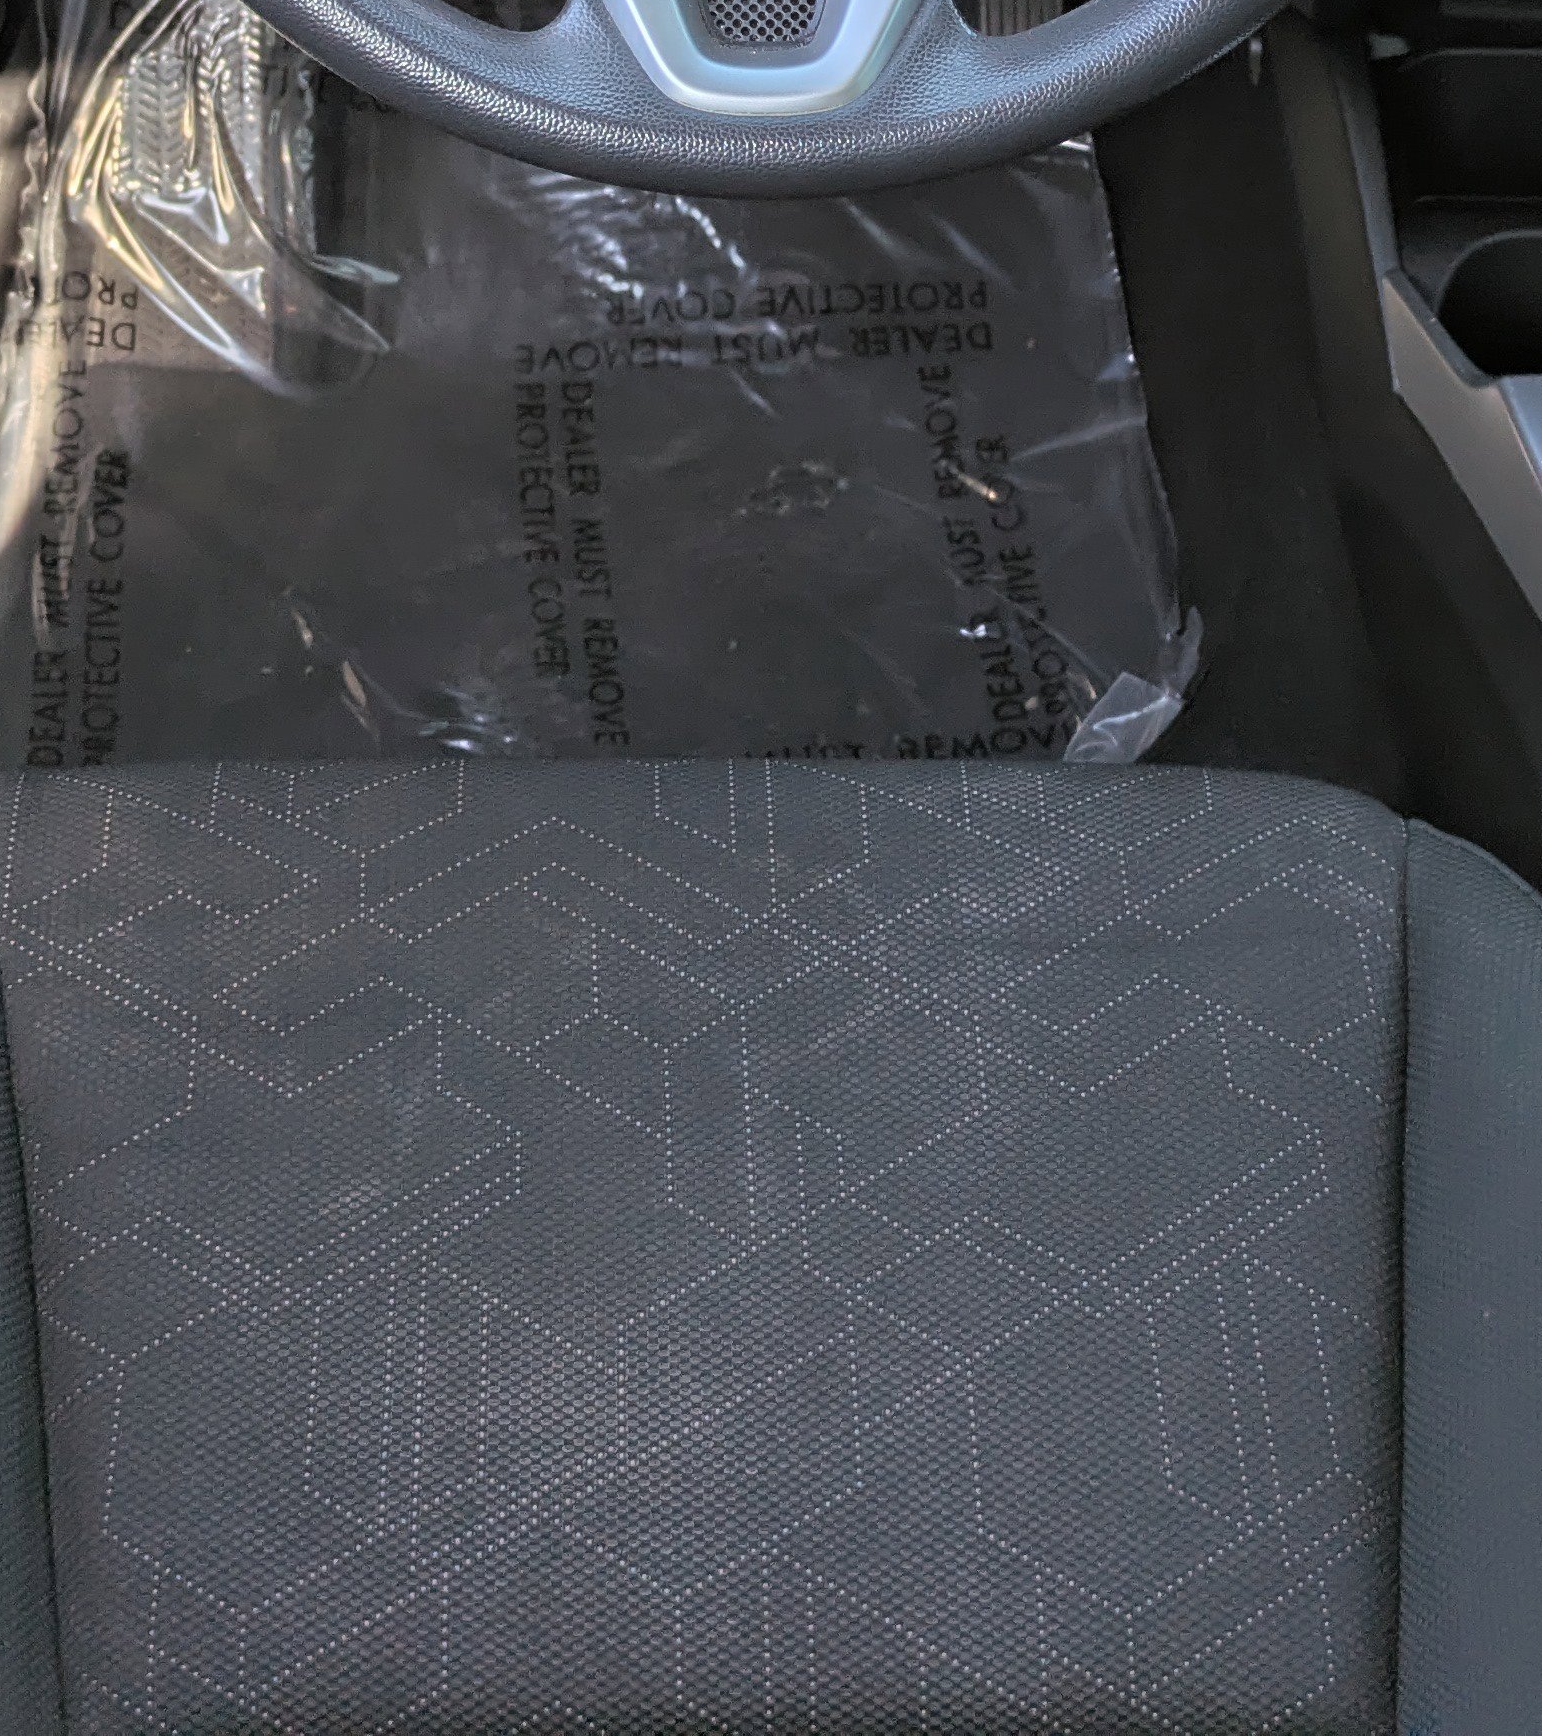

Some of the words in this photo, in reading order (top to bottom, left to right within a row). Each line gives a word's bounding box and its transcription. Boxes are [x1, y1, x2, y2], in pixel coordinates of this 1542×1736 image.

[757, 280, 989, 319] PROTECTIVE
[849, 321, 993, 357] DEALER
[514, 382, 560, 565] PROTECTIVE
[561, 380, 601, 496] DEALER
[87, 450, 129, 564] COVER
[572, 518, 613, 600] MUST
[528, 577, 570, 678] COVER
[583, 617, 631, 746] REMOVE
[26, 650, 68, 768] DEALER
